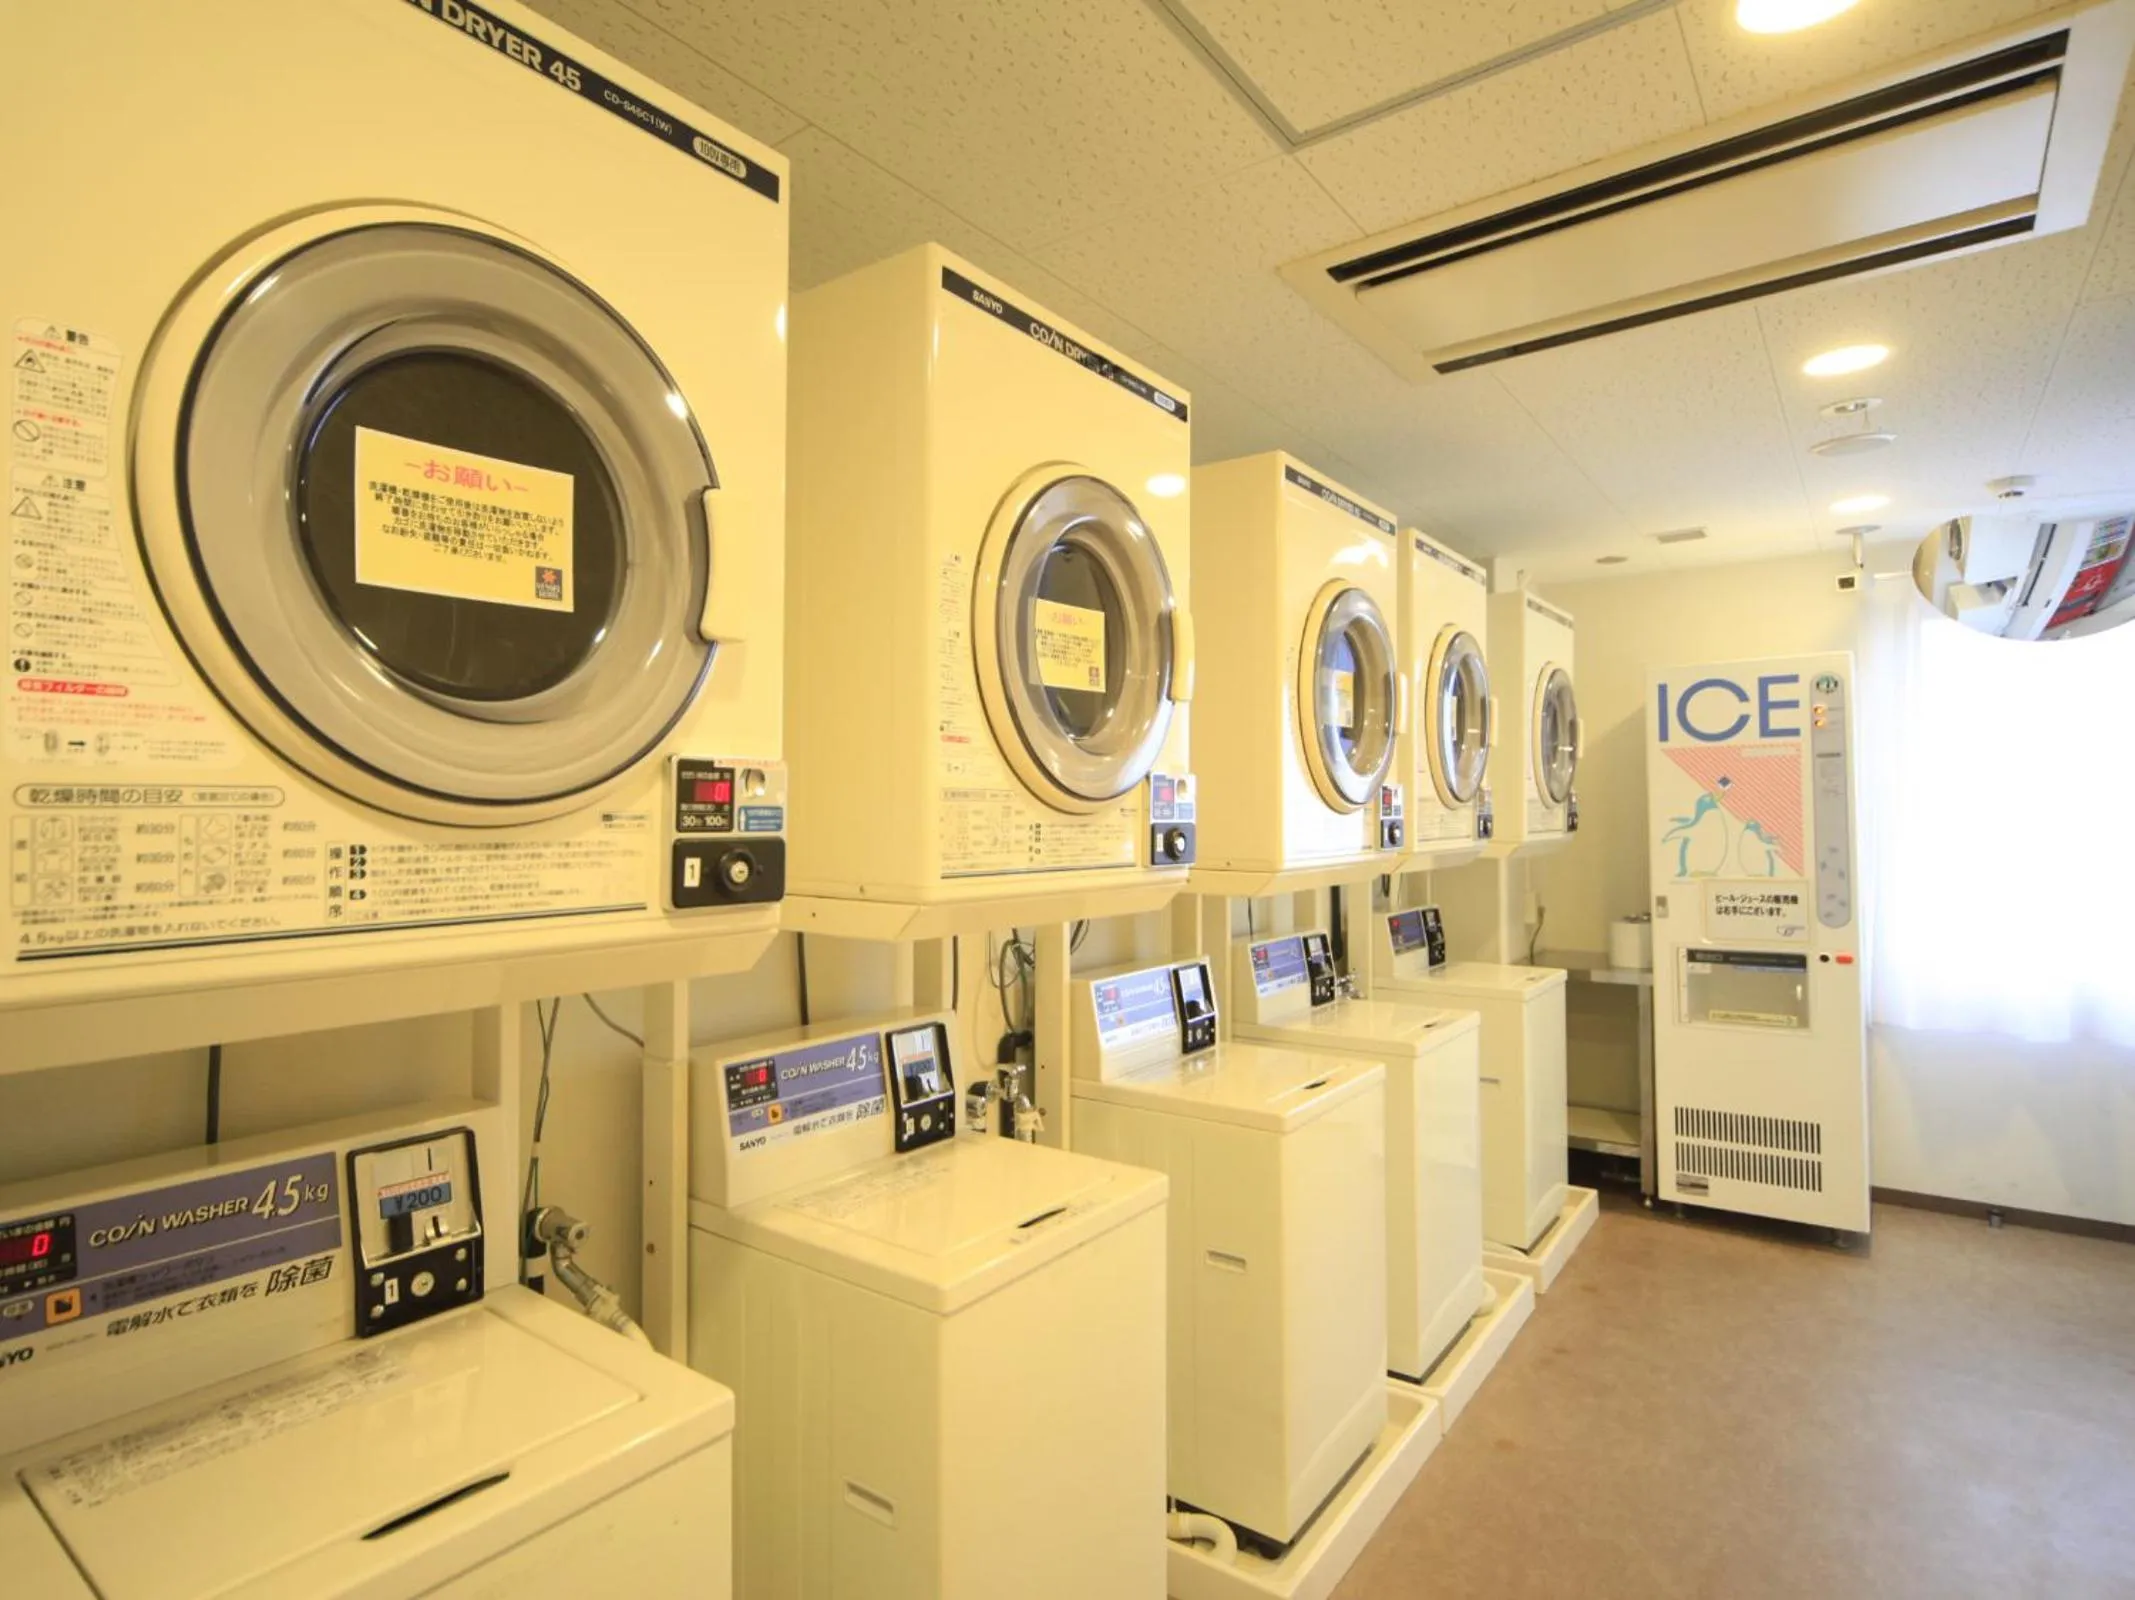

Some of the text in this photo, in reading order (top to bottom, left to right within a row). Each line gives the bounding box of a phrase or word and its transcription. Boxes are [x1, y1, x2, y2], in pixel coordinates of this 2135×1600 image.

[442, 1, 582, 92] DRYER 45
[972, 289, 1003, 315] SANYO
[1657, 674, 1801, 742] ICE
[29, 787, 183, 804] 乾燥時間の目安
[739, 1136, 767, 1151] SANYO
[162, 1196, 249, 1231] WASHER
[31, 1233, 51, 1257] 0
[264, 1254, 335, 1297] 除菌
